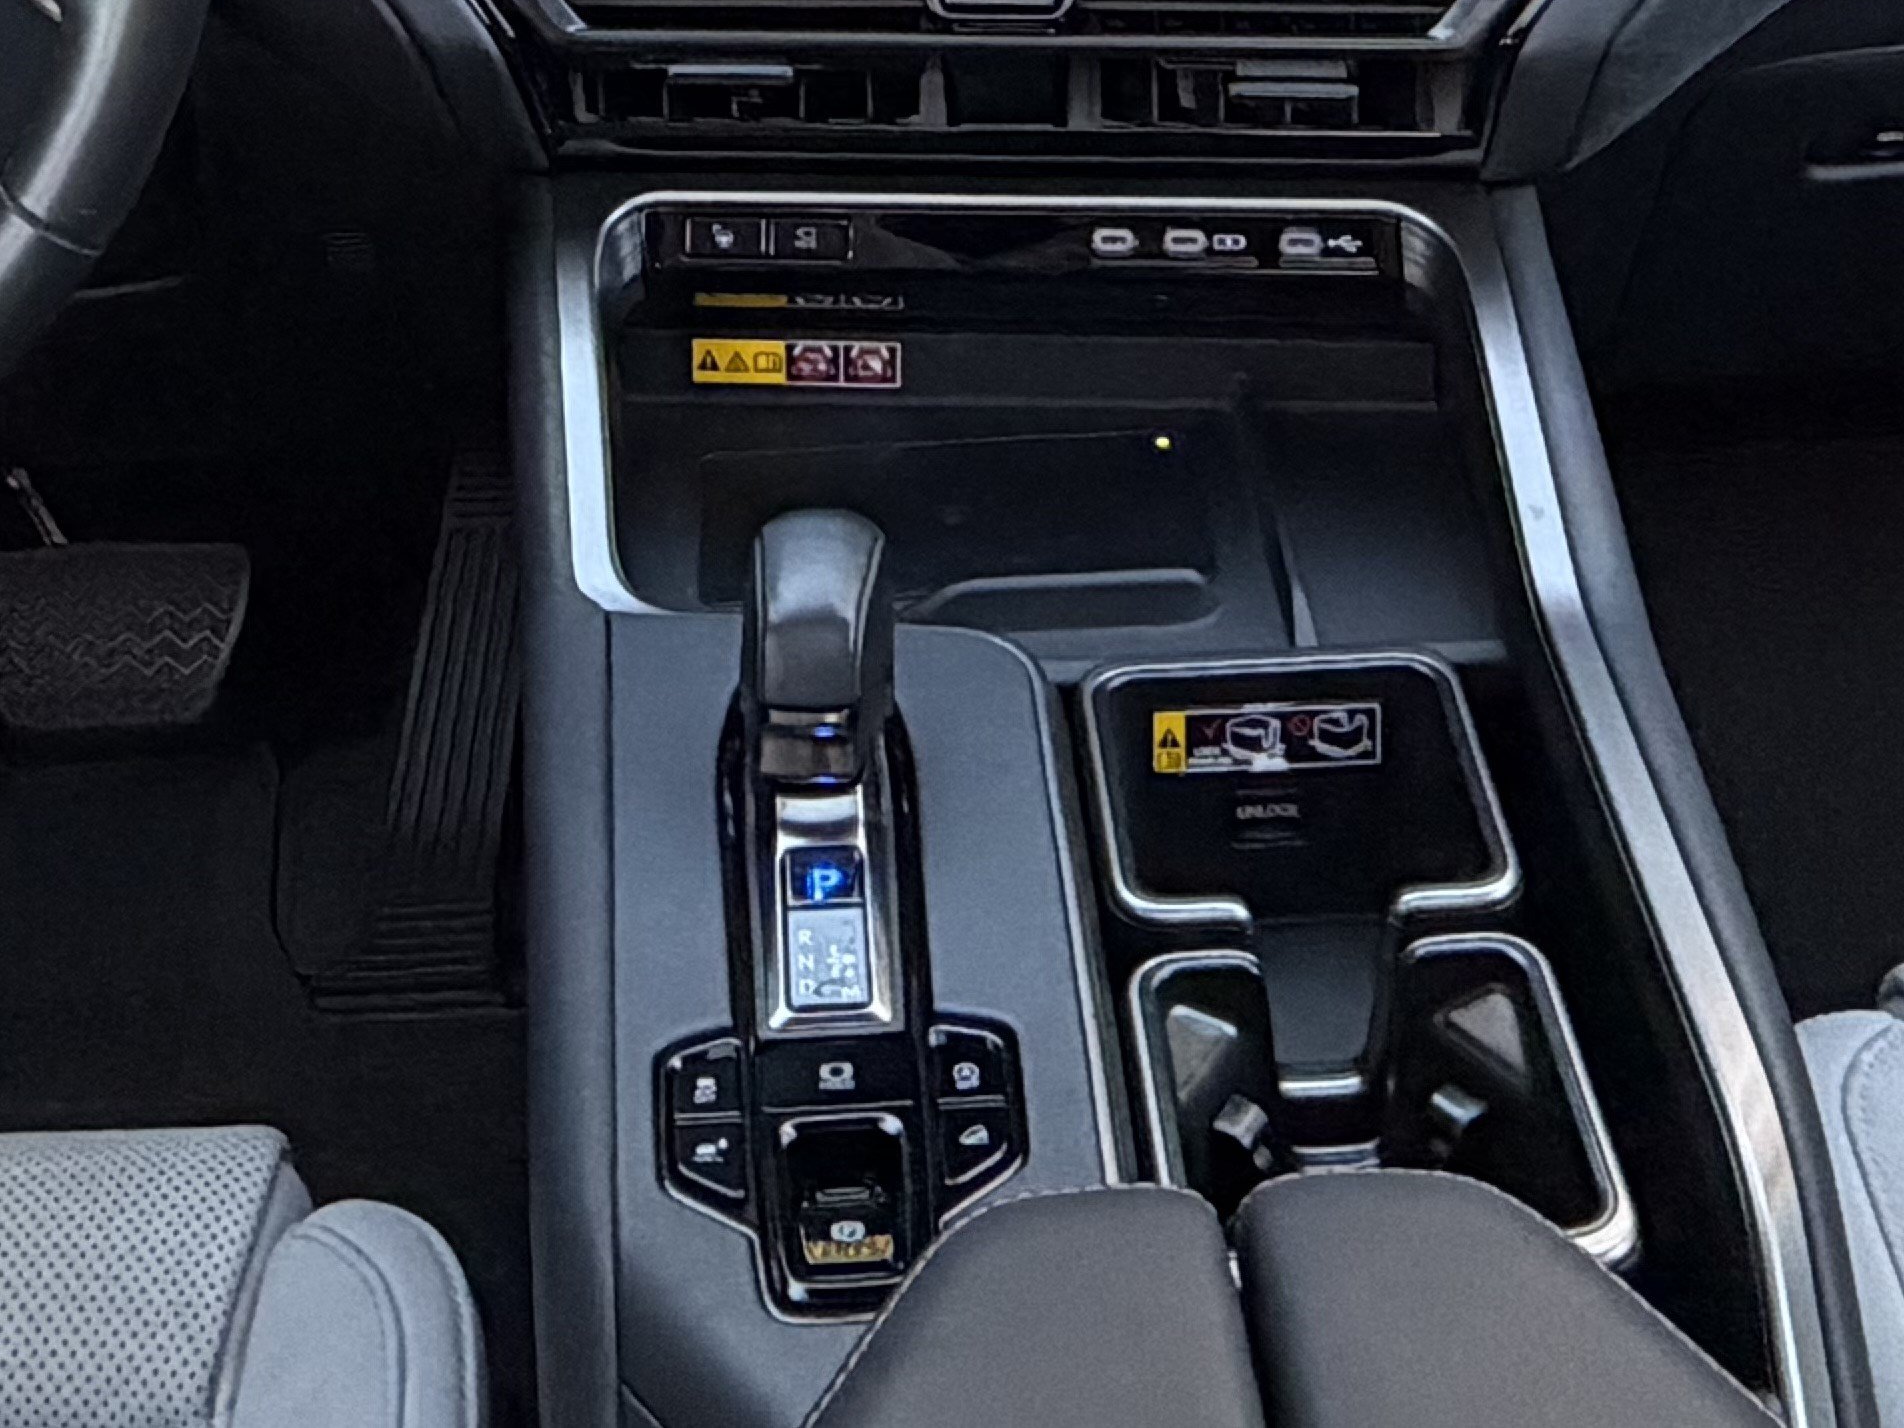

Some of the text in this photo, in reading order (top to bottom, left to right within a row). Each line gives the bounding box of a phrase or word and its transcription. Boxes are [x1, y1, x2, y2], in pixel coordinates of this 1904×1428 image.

[1235, 802, 1301, 820] UNLOCK
[806, 863, 844, 901] P
[798, 928, 812, 945] R
[798, 954, 814, 972] N
[798, 978, 815, 995] D
